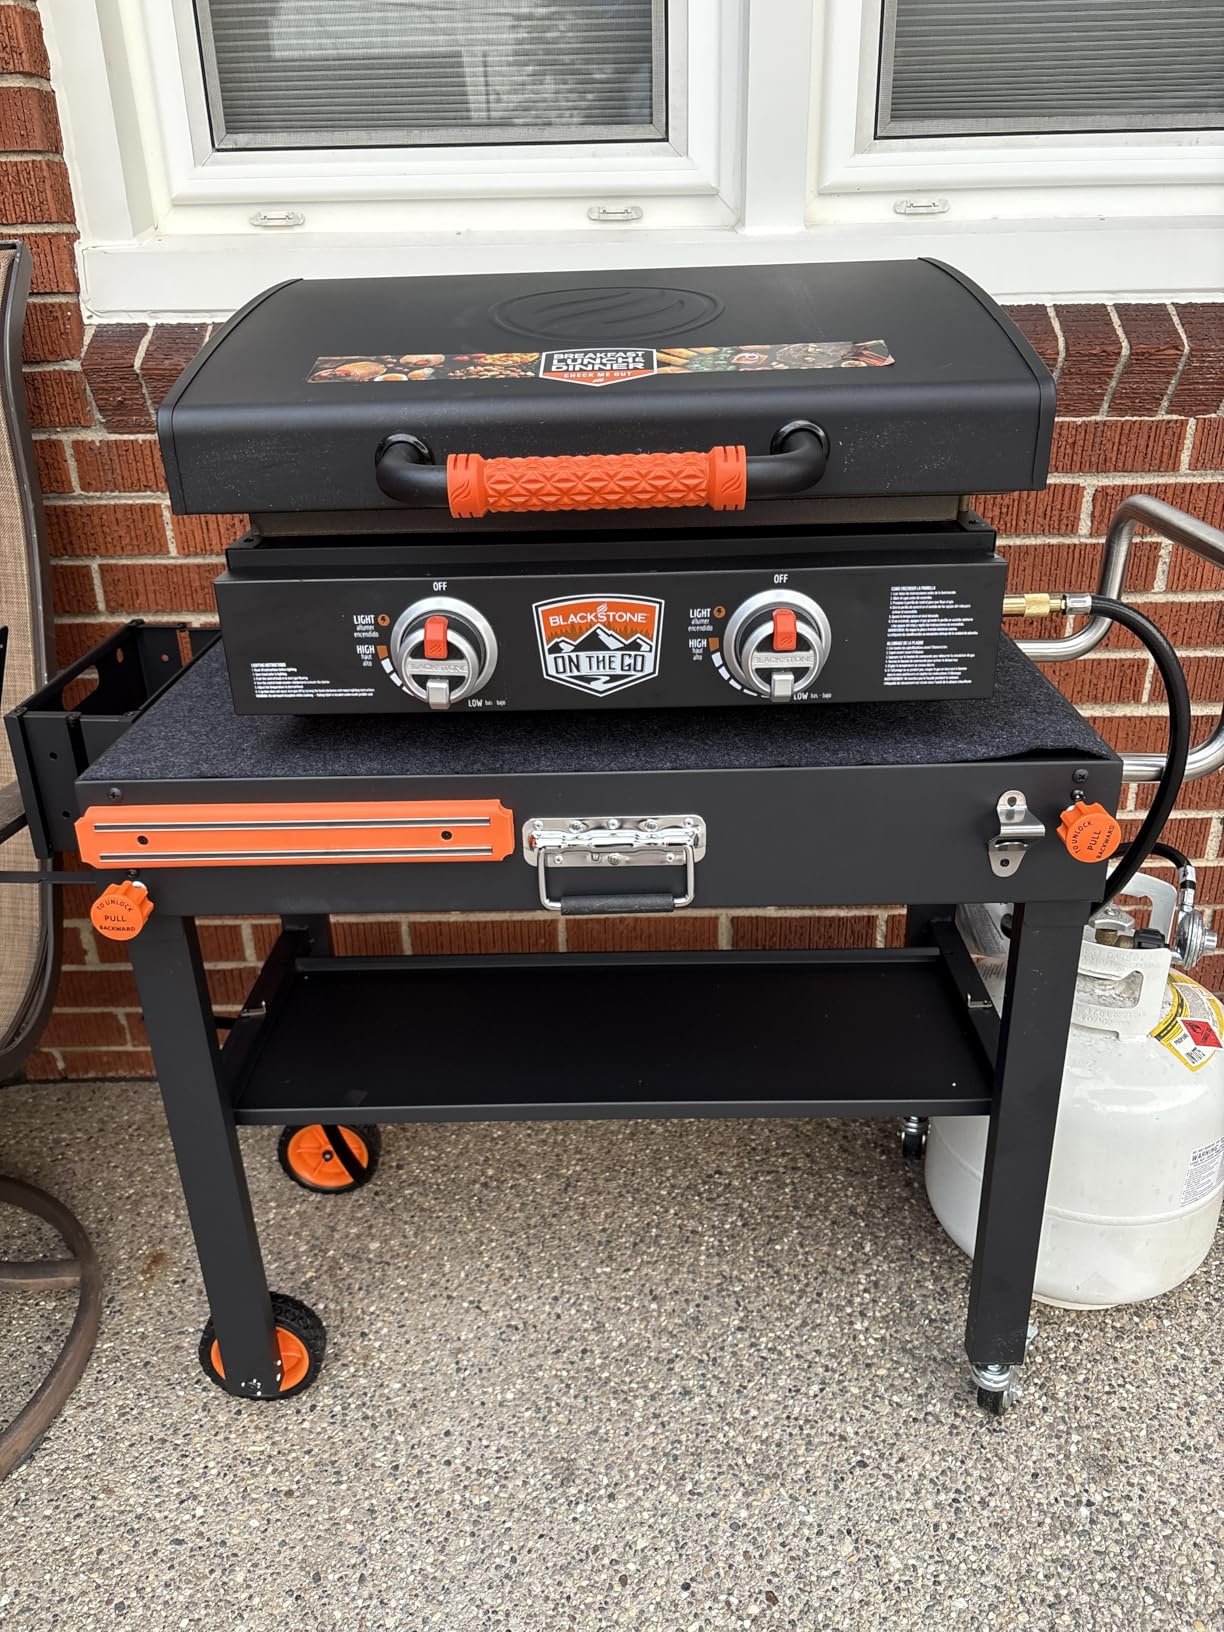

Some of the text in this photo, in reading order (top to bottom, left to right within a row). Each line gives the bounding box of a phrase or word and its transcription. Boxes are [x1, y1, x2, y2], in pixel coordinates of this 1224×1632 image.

[552, 357, 630, 365] LUNCH
[553, 351, 645, 360] BREAKFAST
[551, 362, 645, 372] DINNER
[773, 573, 789, 584] OFF
[432, 581, 448, 592] OFF
[689, 607, 712, 618] LIGHT
[353, 614, 375, 625] LIGHT
[549, 611, 648, 627] BLACKSTONE
[688, 638, 707, 649] HIGH
[356, 644, 376, 655] HIGH
[553, 653, 645, 675] ON THE GO
[467, 699, 483, 707] LOW
[1071, 820, 1094, 854] TO UNLOCK
[1086, 830, 1103, 851] PULL
[1095, 825, 1116, 859] BACKWARD
[96, 898, 134, 913] TO UNLOCK
[103, 914, 128, 923] PULL
[99, 924, 136, 932] BACKWARD
